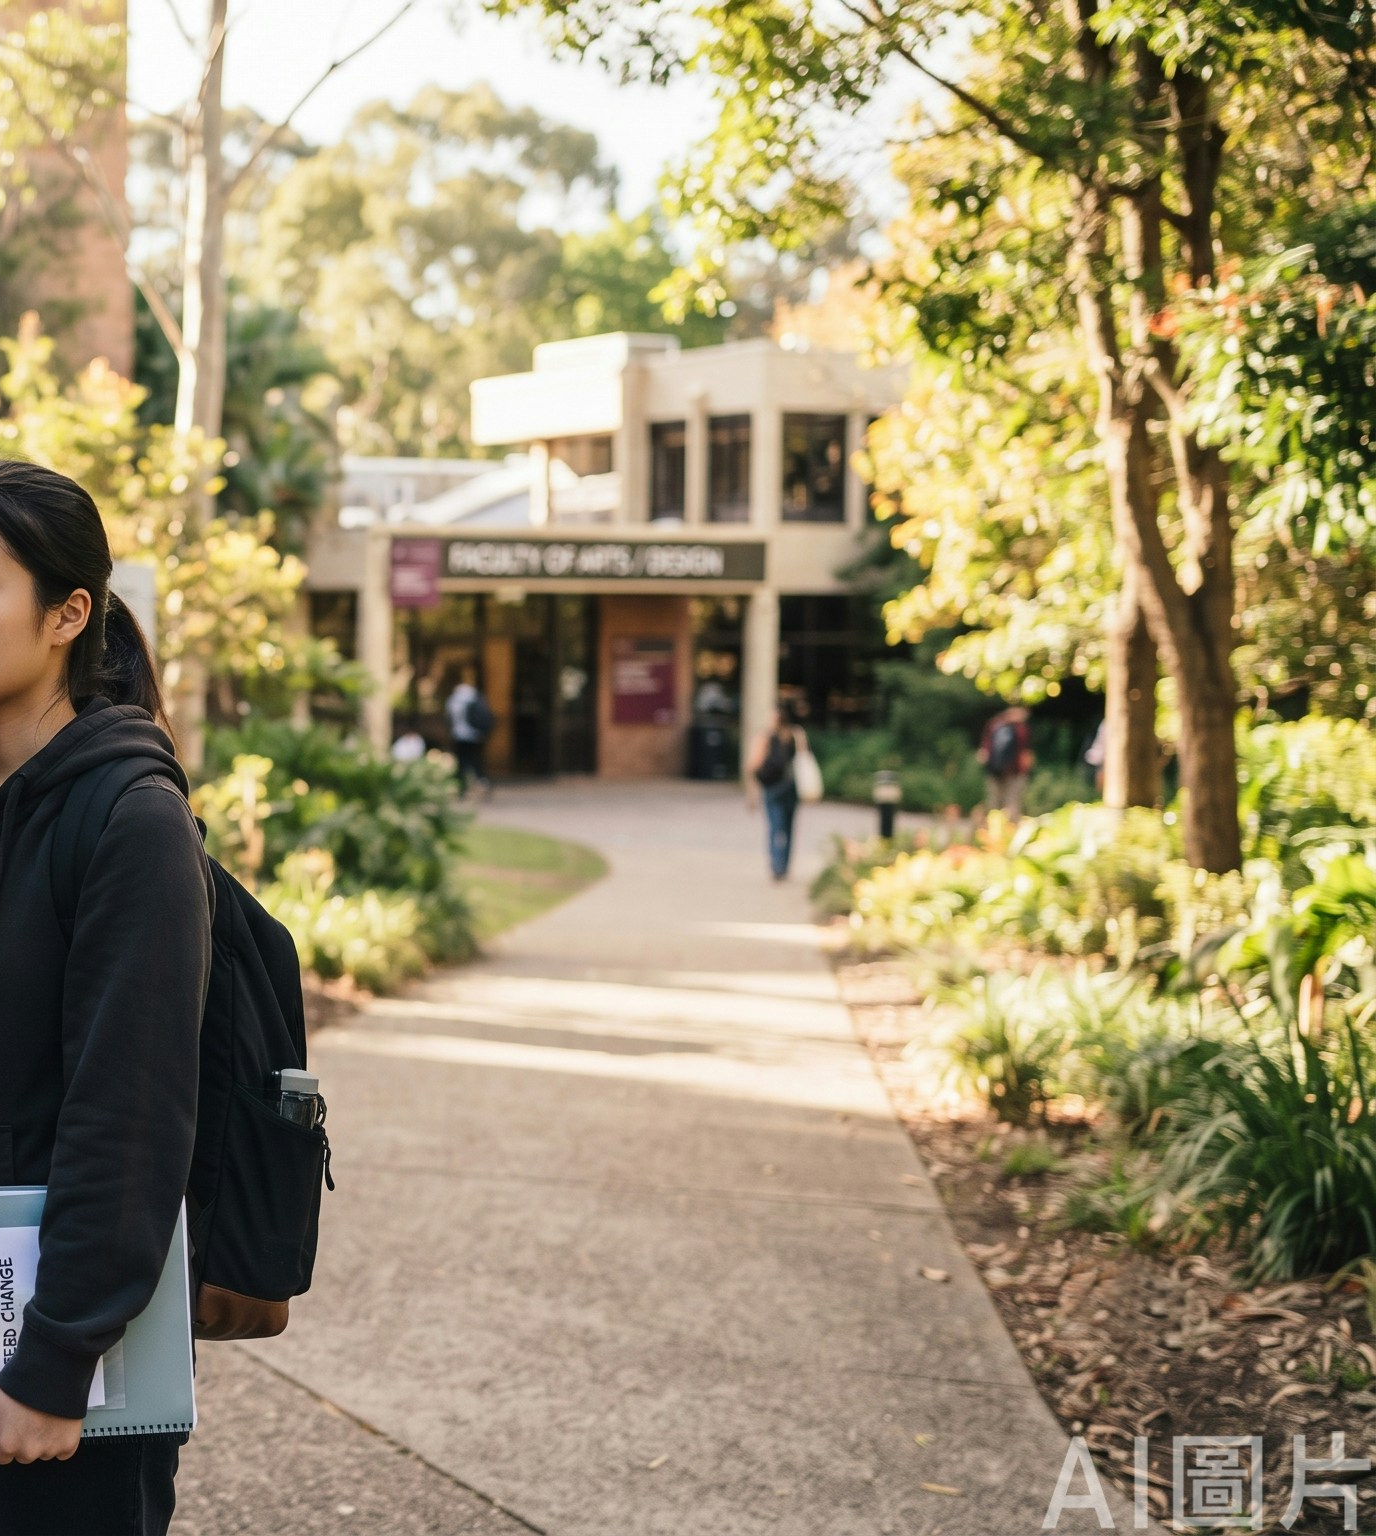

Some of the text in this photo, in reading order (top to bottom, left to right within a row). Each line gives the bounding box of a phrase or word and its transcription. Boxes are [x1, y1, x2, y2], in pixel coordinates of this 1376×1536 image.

[448, 541, 542, 575] FACULTY
[542, 543, 578, 576] OF
[576, 543, 634, 576] ARTS
[645, 544, 724, 577] DESIGN
